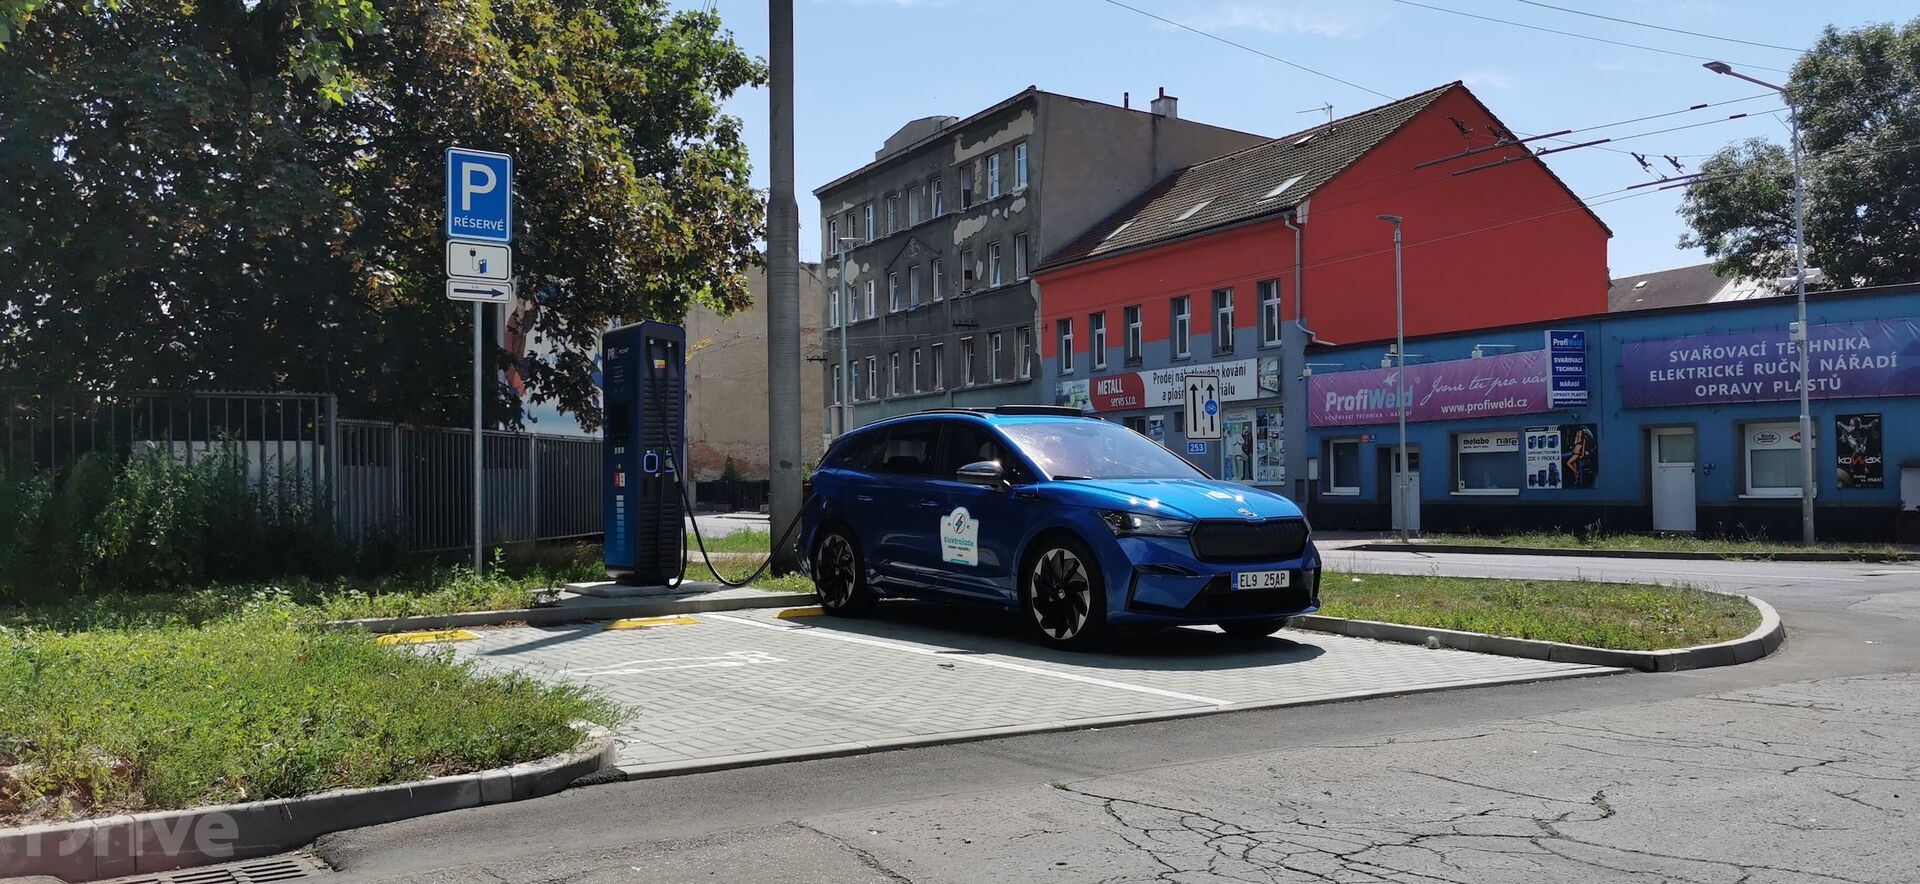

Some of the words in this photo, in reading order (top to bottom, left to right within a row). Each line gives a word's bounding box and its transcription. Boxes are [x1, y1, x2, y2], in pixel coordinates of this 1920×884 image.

[461, 161, 497, 211] P
[454, 215, 504, 231] RÉSERVÉ
[1553, 338, 1583, 346] ProfiWeld
[1669, 340, 1767, 363] SVAŘOVACÍ
[1152, 369, 1174, 386] Prodej
[1222, 362, 1246, 378] kování
[1650, 361, 1745, 382] ELEKTRICKÉ
[1820, 351, 1898, 372] NÁŘADÍ
[1097, 378, 1123, 395] METALL
[1420, 375, 1465, 406] Jsme
[1484, 376, 1518, 396] pro
[1695, 380, 1764, 397] OPRAVY
[1773, 373, 1841, 393] PLASTŮ
[1110, 394, 1124, 407] servis
[1162, 391, 1166, 401] a
[1325, 384, 1414, 412] ProfiWeld
[1390, 409, 1412, 417] NÁDÍ
[1441, 397, 1528, 414] www.profiweld.cz
[1189, 443, 1204, 452] 253
[1240, 574, 1258, 587] EL9
[1264, 572, 1286, 586] 25AP
